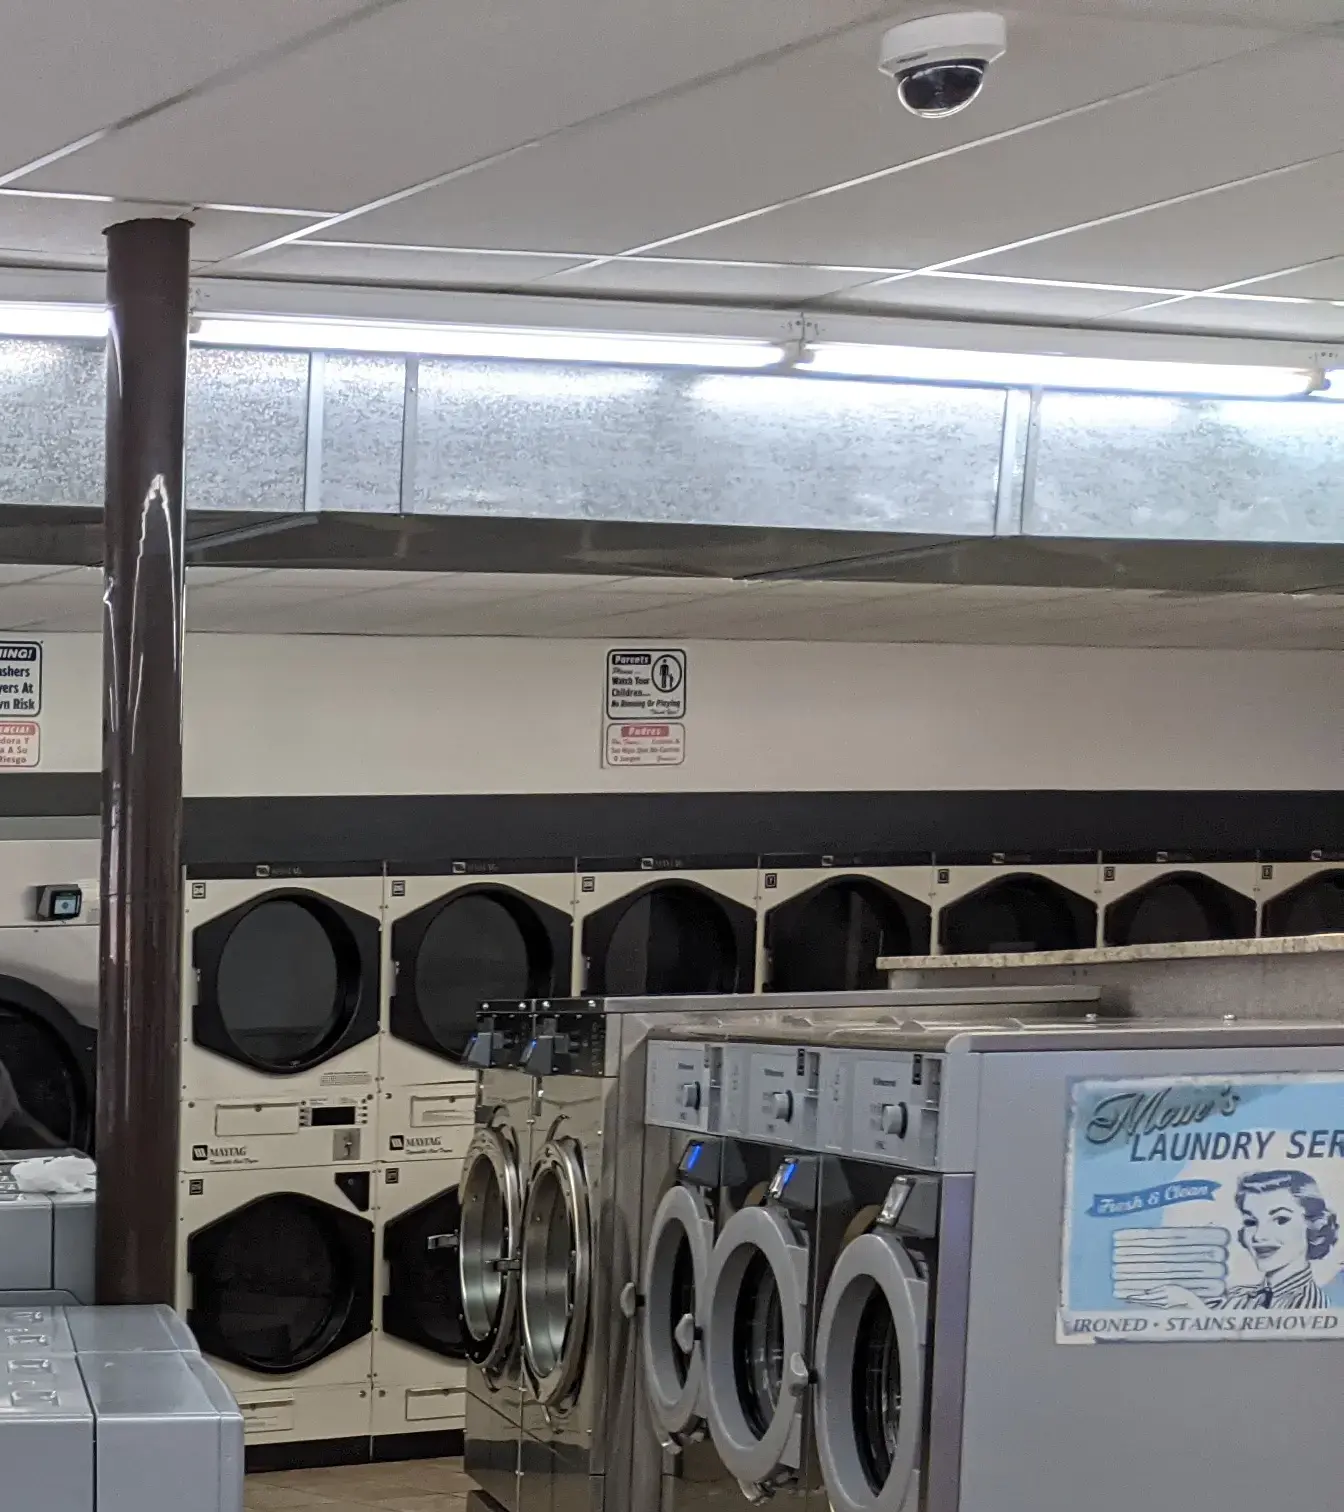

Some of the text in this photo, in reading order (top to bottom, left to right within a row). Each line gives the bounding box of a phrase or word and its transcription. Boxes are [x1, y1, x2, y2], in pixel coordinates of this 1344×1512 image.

[22, 682, 33, 694] At
[13, 698, 35, 710] Risk
[406, 1135, 442, 1147] MAYTAG
[1130, 1129, 1344, 1162] LAUNDRY SER
[210, 1147, 247, 1157] MAYTAG
[1073, 1315, 1339, 1333] IRONED STAINS REMOVED
